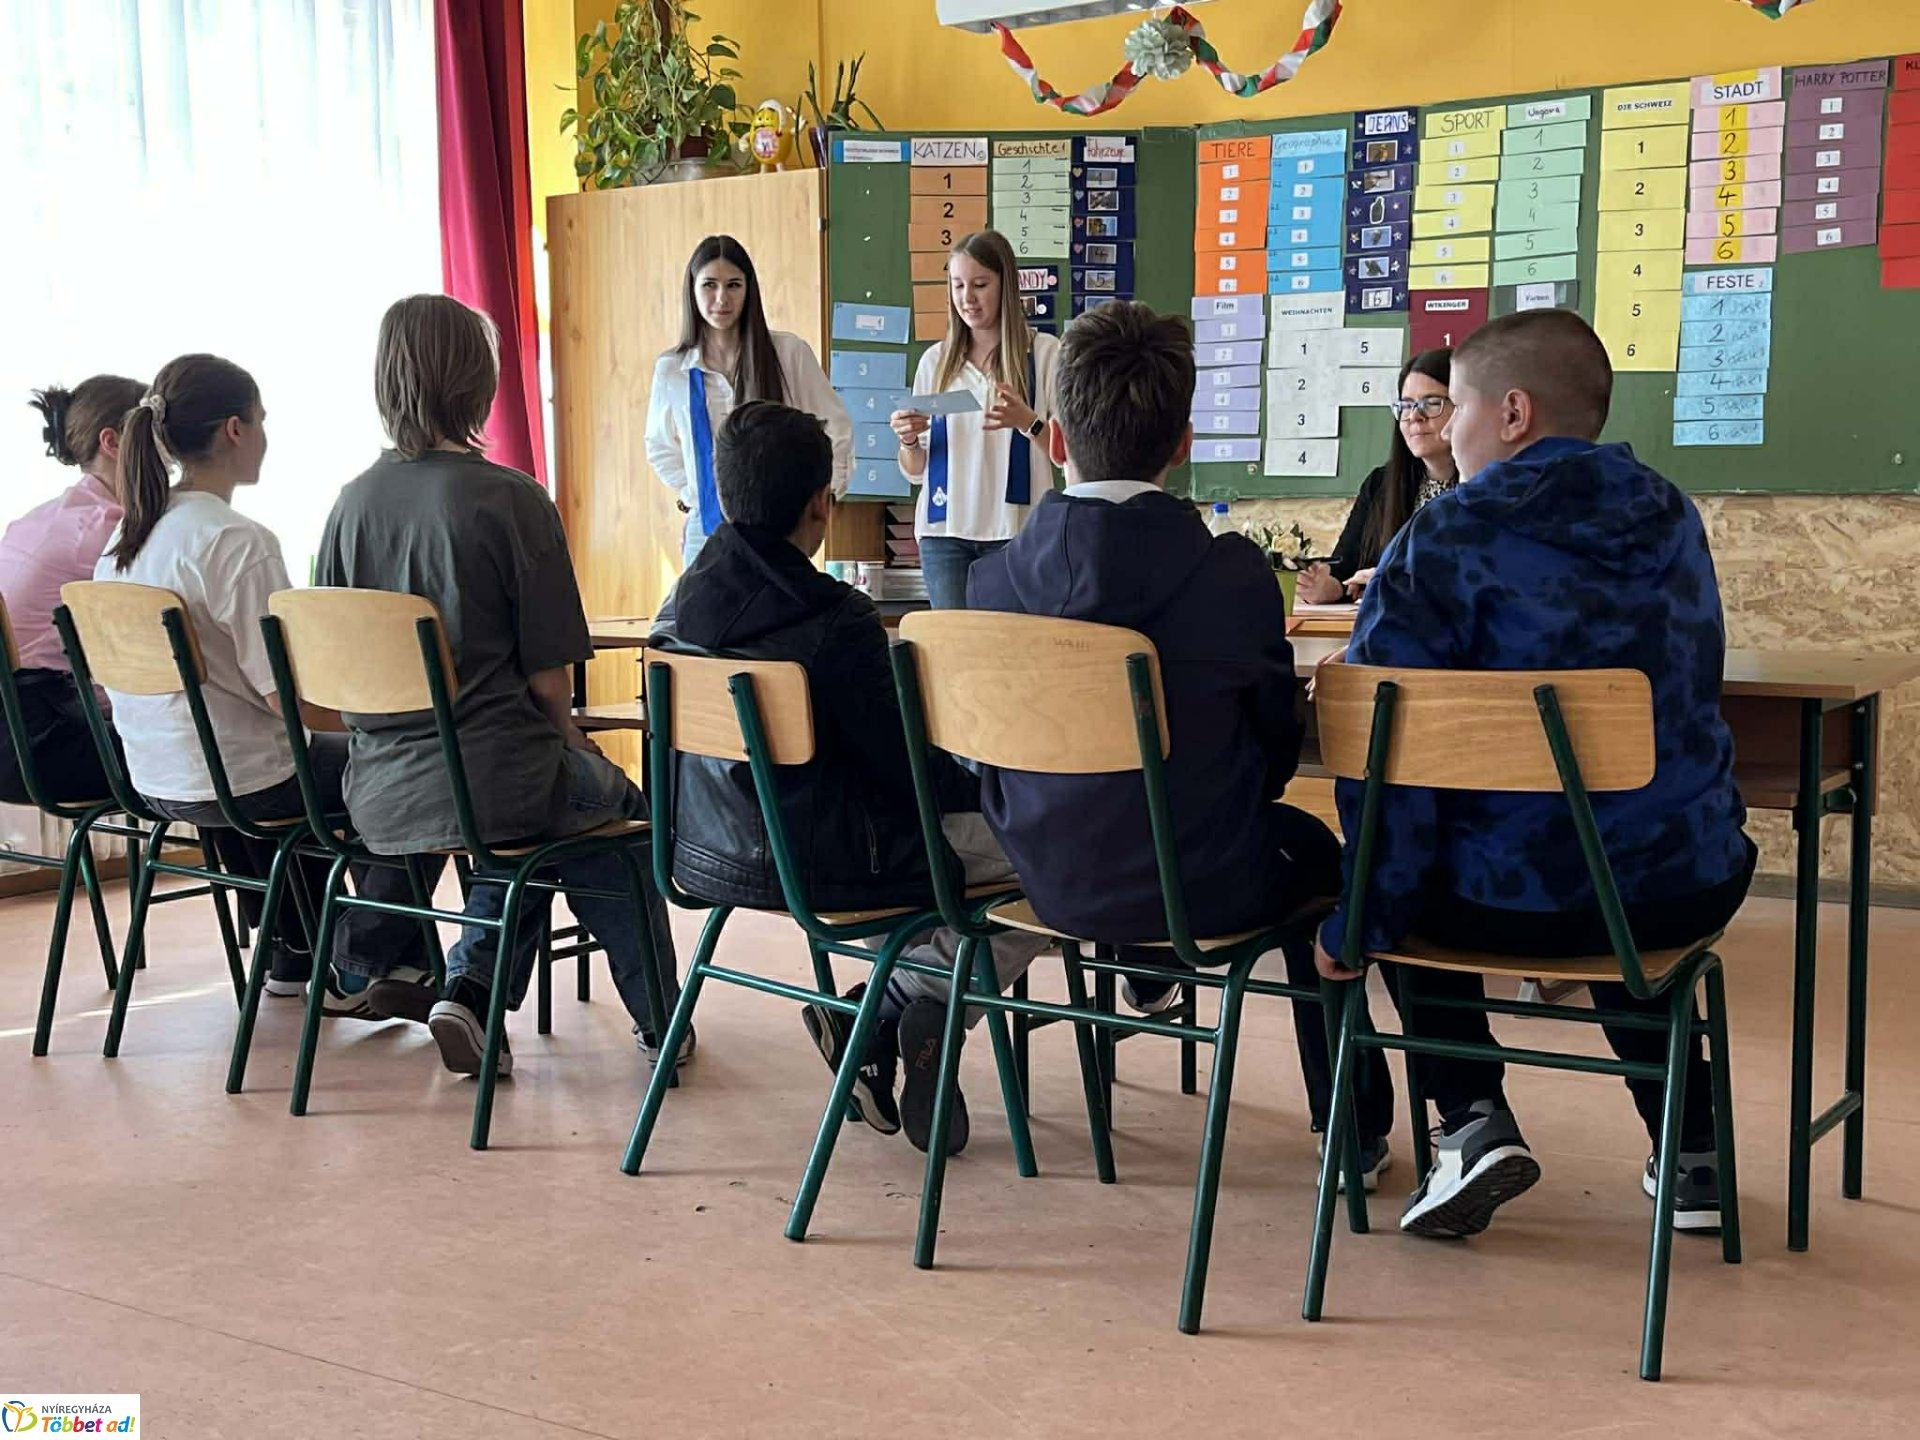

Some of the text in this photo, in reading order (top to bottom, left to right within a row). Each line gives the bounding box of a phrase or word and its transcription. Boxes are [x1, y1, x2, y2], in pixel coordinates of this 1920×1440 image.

[1794, 69, 1886, 89] HARRY POTTER
[1713, 81, 1763, 99] STADT
[1634, 100, 1672, 110] SCHWEIZ
[1368, 114, 1407, 132] JEANS
[1441, 110, 1495, 133] SPORT
[1725, 107, 1736, 126] 1
[1535, 128, 1543, 147] 1
[1724, 132, 1739, 154] 2
[913, 141, 976, 160] KATZEN
[1211, 141, 1255, 158] TIERE
[1638, 141, 1644, 153] 1
[1022, 159, 1031, 173] 1
[1532, 157, 1544, 170] 2
[1725, 160, 1736, 181] 3
[943, 173, 951, 189] 1
[1021, 175, 1033, 189] 2
[1528, 182, 1538, 199] 3
[1635, 182, 1645, 195] 2
[1022, 192, 1031, 204] 3
[1719, 186, 1737, 206] 4
[943, 202, 954, 218] 2
[1020, 210, 1027, 221] 4
[1528, 208, 1535, 222] 4
[1021, 226, 1029, 237] 5
[1635, 223, 1643, 236] 3
[1723, 214, 1735, 237] 5
[941, 229, 951, 245] 3
[1525, 234, 1534, 250] 5
[1019, 241, 1028, 254] 6
[1717, 241, 1733, 259] 6
[1528, 262, 1537, 276] 6
[1634, 264, 1642, 276] 4
[1707, 274, 1755, 289] FESTE
[1216, 301, 1234, 310] Film
[1281, 307, 1333, 316] WEIHNACHTEN
[1632, 304, 1641, 317] 5
[1711, 299, 1724, 316] 1
[1443, 333, 1451, 346] 1
[1708, 324, 1725, 342] 2
[1301, 343, 1307, 355] 1
[1361, 342, 1368, 354] 5
[1627, 344, 1636, 357] 6
[1709, 349, 1723, 367] 3
[858, 362, 867, 376] 3
[1298, 378, 1306, 391] 2
[1362, 381, 1370, 393] 6
[1710, 373, 1730, 391] 4
[866, 397, 874, 409] 4
[1701, 397, 1715, 414] 5
[1298, 414, 1305, 425] 3
[1708, 424, 1719, 441] 6
[867, 434, 876, 447] 5
[1298, 451, 1307, 464] 4
[868, 470, 877, 481] 6
